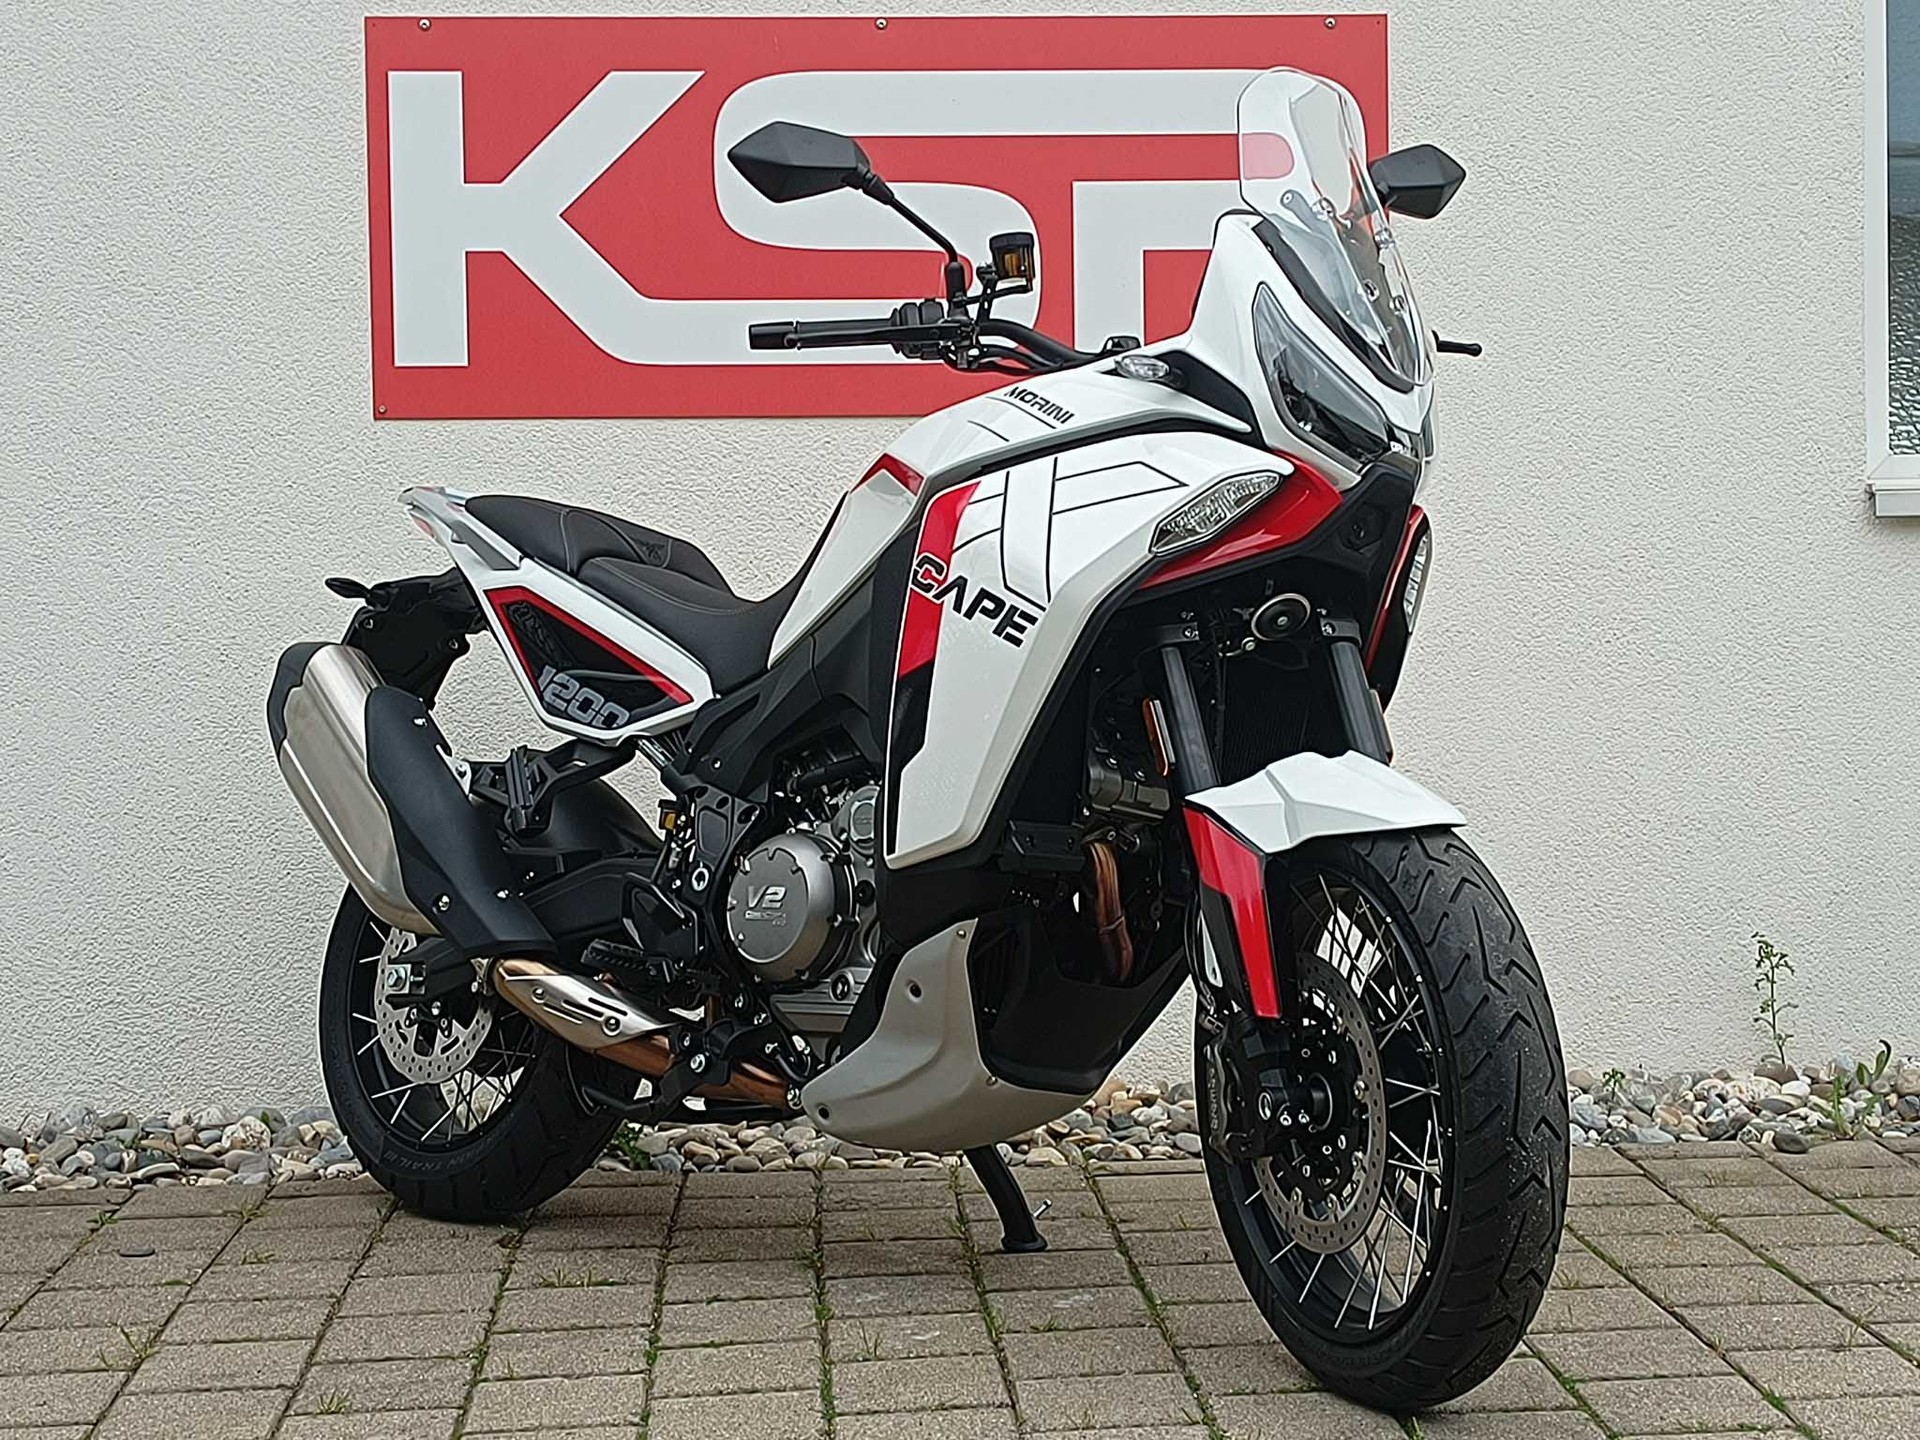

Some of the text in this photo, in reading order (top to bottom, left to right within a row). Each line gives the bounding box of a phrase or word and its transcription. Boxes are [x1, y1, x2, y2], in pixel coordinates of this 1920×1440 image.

[1004, 386, 1076, 425] MORINI
[911, 552, 1041, 648] CAPE
[538, 665, 631, 729] 1200
[747, 885, 787, 909] V2
